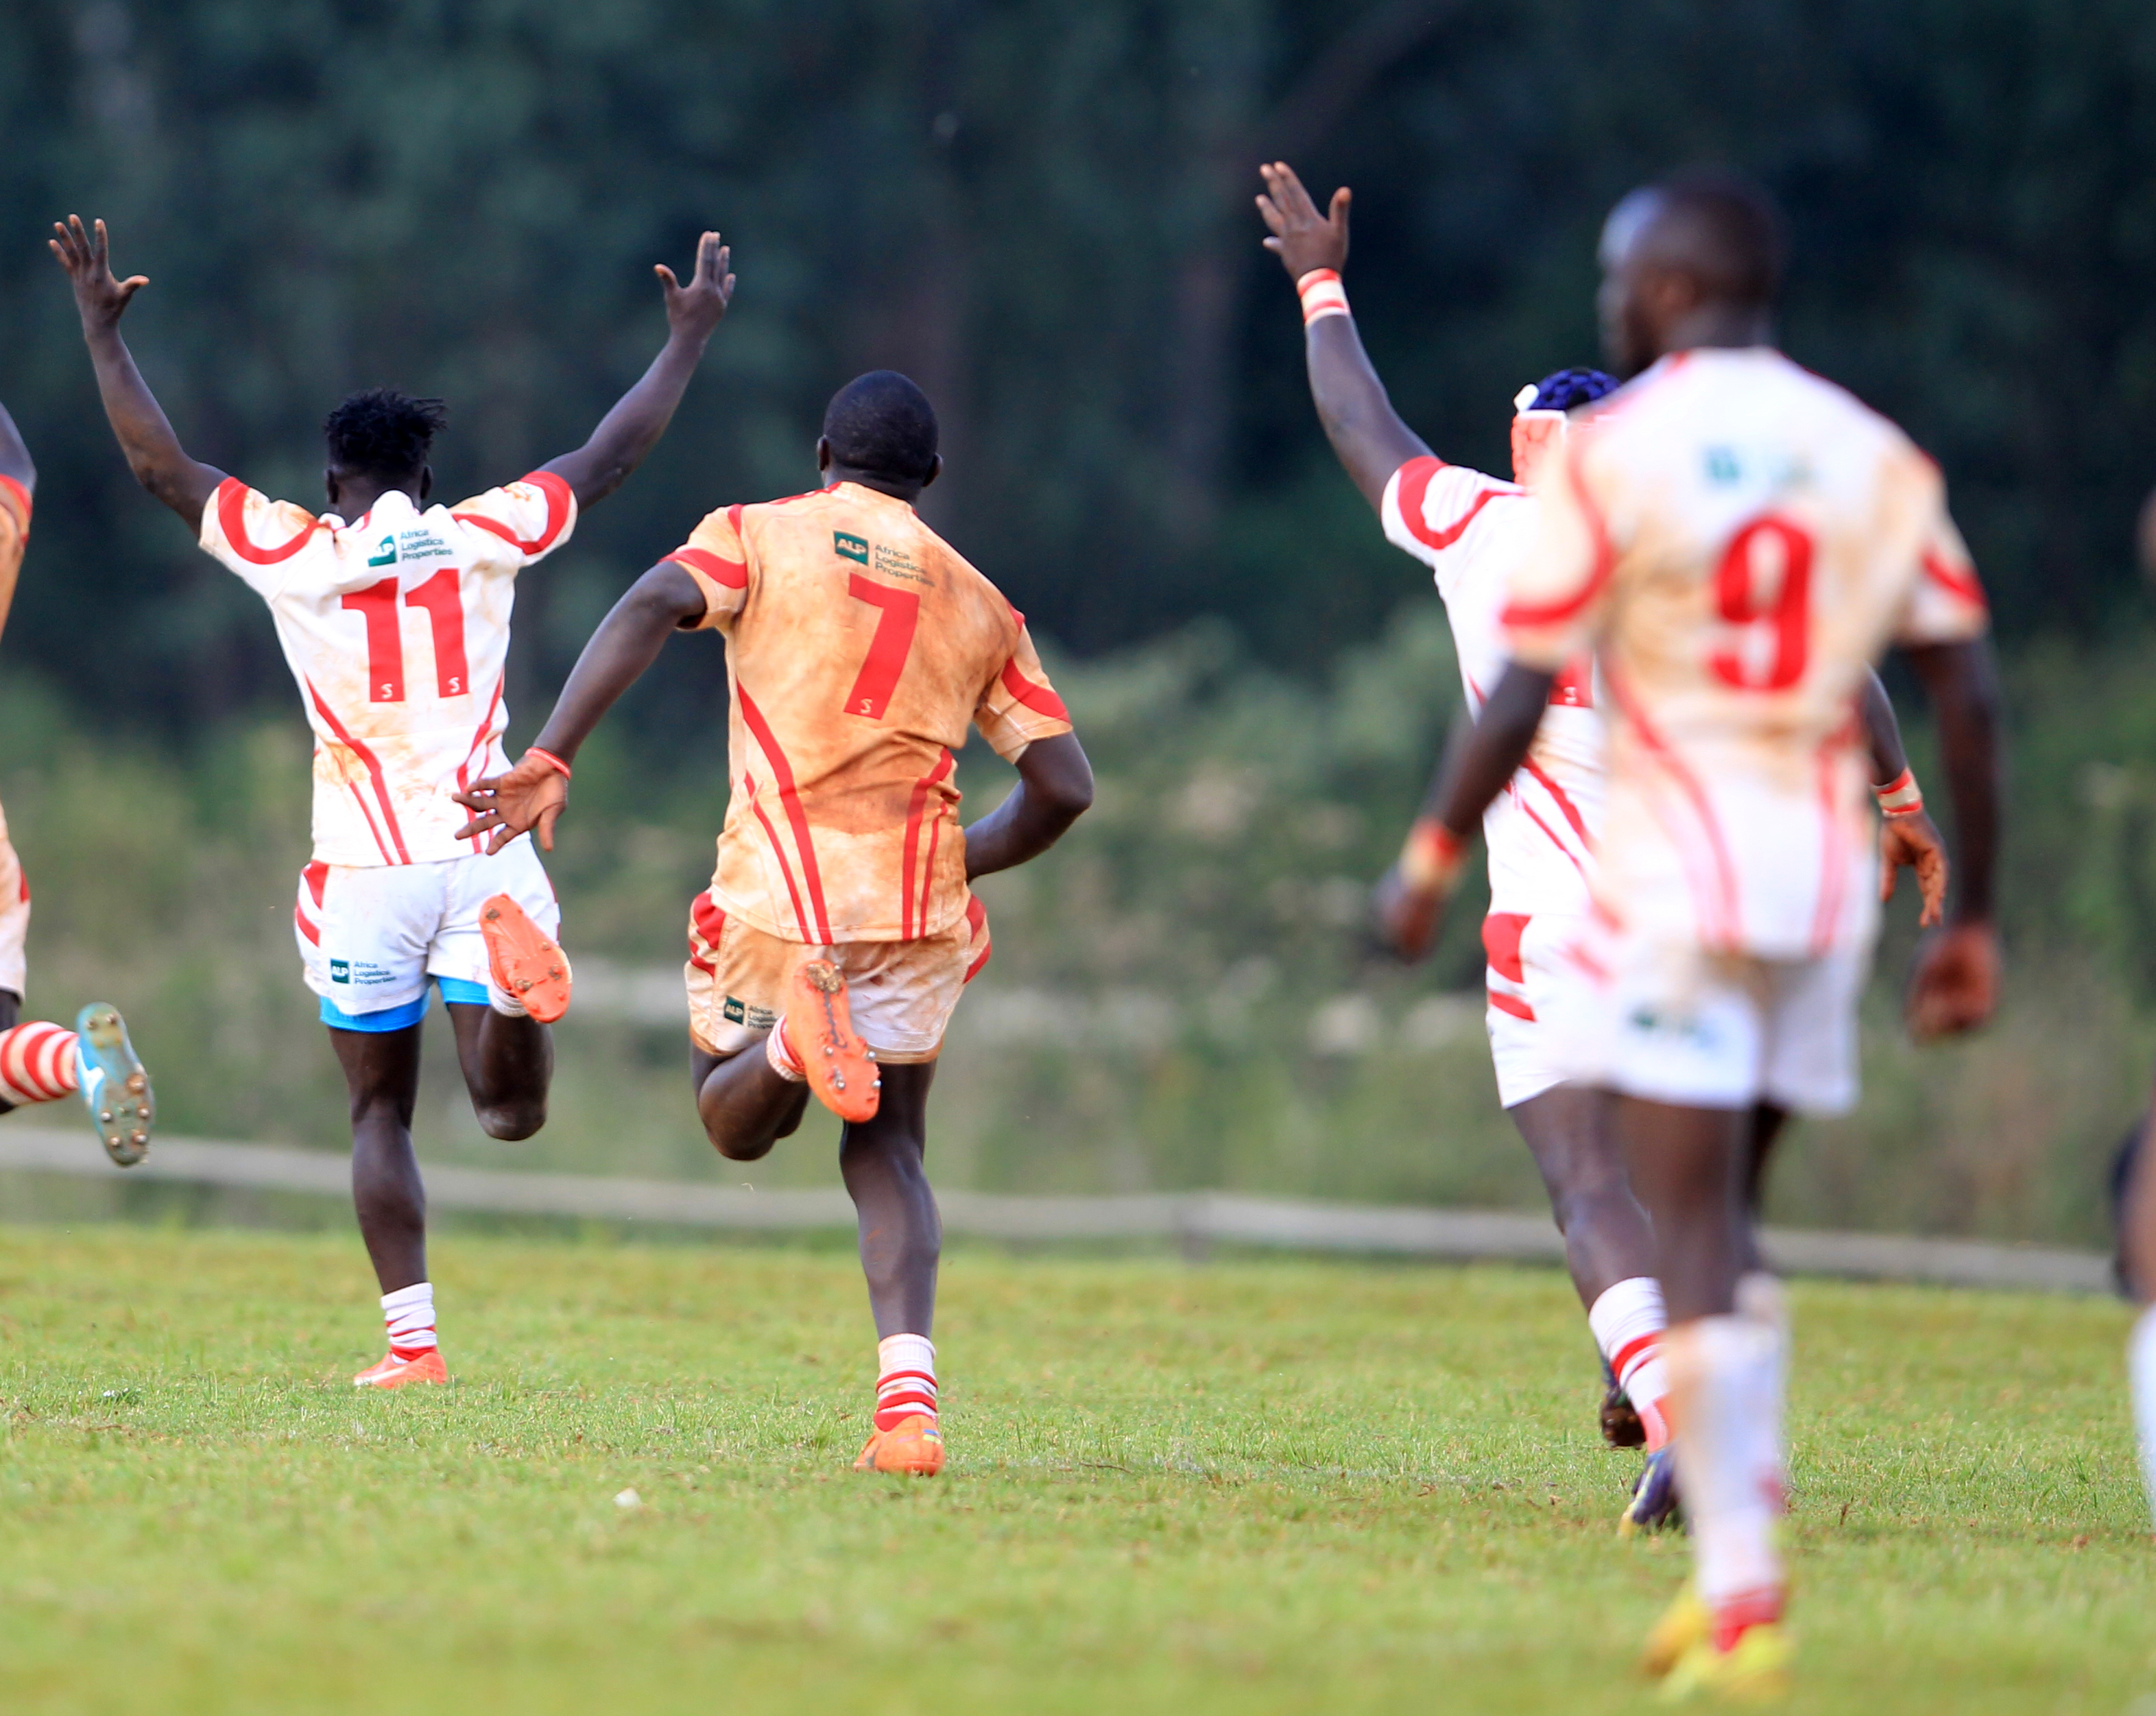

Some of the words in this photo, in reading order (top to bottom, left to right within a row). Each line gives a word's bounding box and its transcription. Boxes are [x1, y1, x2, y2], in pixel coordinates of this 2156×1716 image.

[402, 538, 444, 551] Logistics
[837, 538, 866, 554] ALP
[875, 545, 910, 560] Africa
[403, 549, 453, 561] Properties
[1711, 517, 1811, 689] 9
[342, 568, 469, 702] 11
[843, 571, 920, 720] 7
